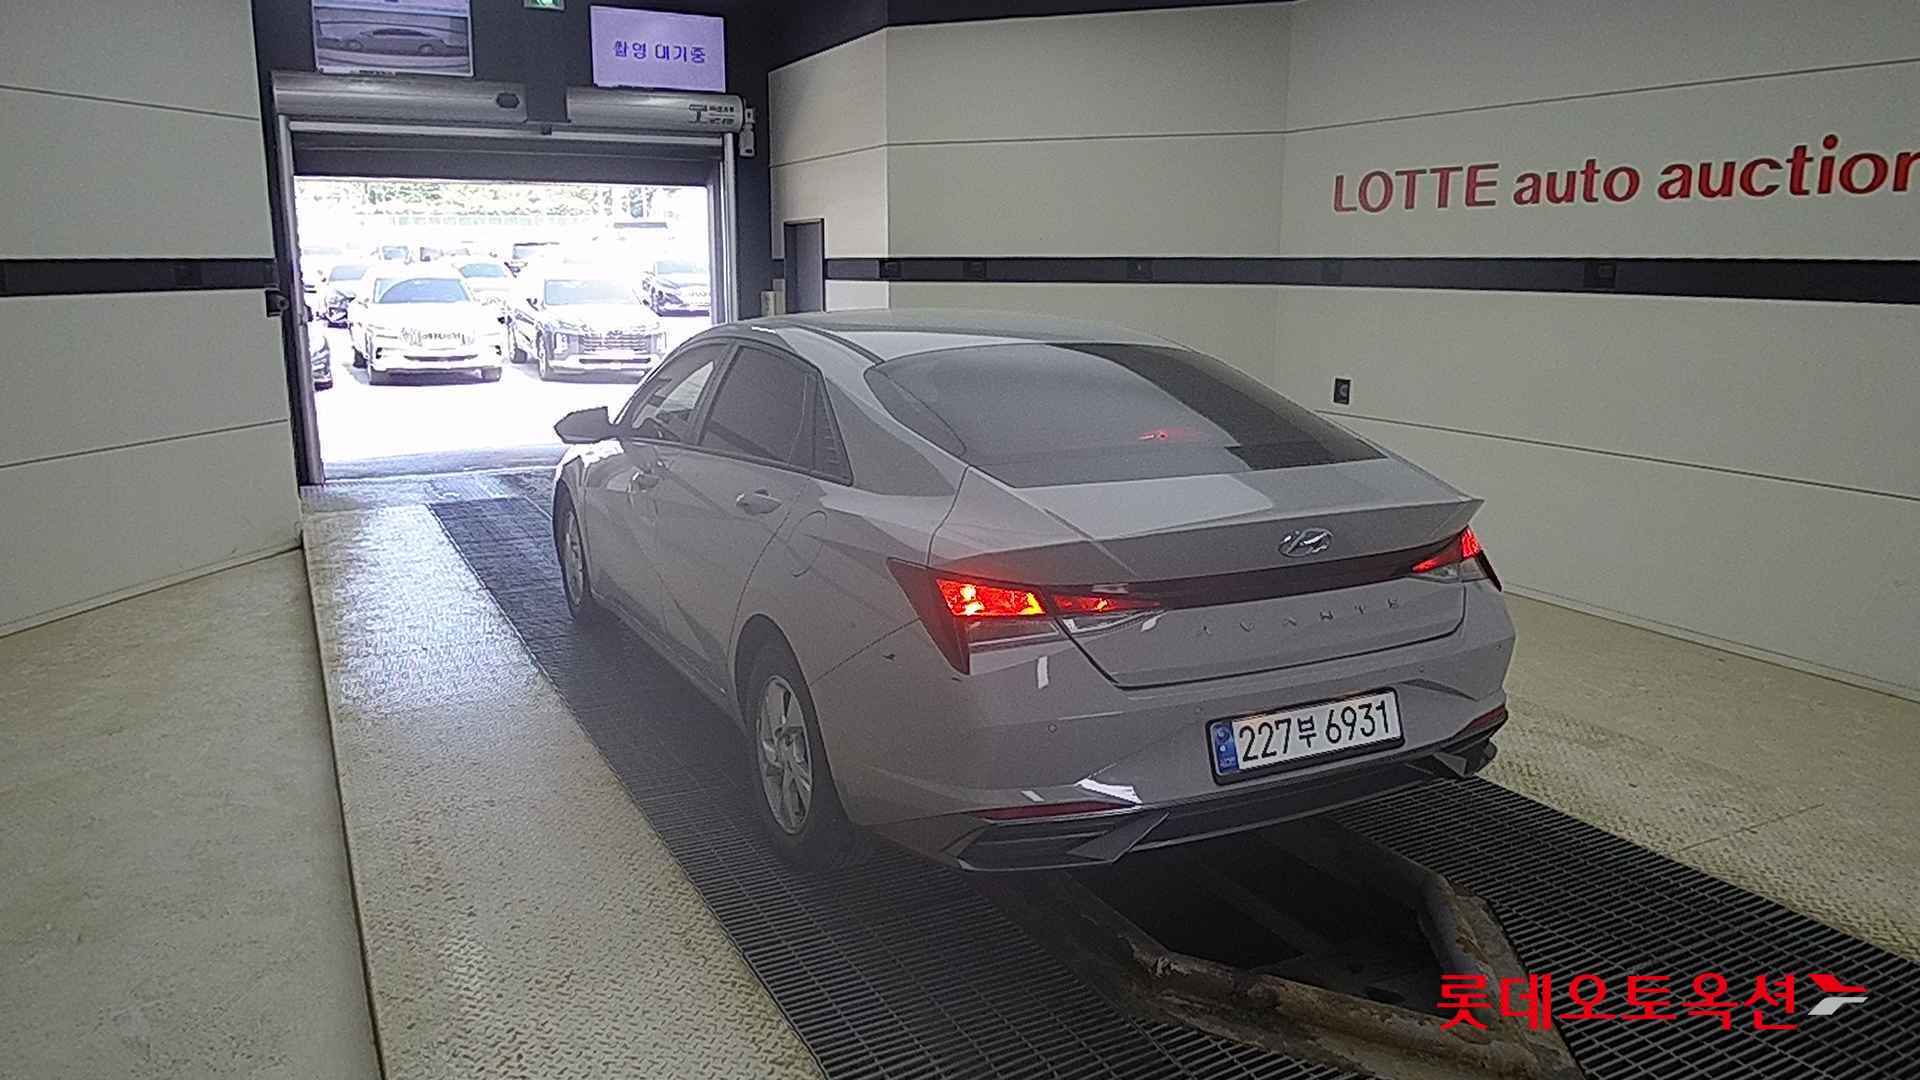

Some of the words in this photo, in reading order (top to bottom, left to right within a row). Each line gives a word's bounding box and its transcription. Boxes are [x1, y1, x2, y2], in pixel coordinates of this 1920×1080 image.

[655, 43, 706, 65] 대기중
[1333, 162, 1500, 213] LOTTE
[1513, 158, 1640, 206] auto
